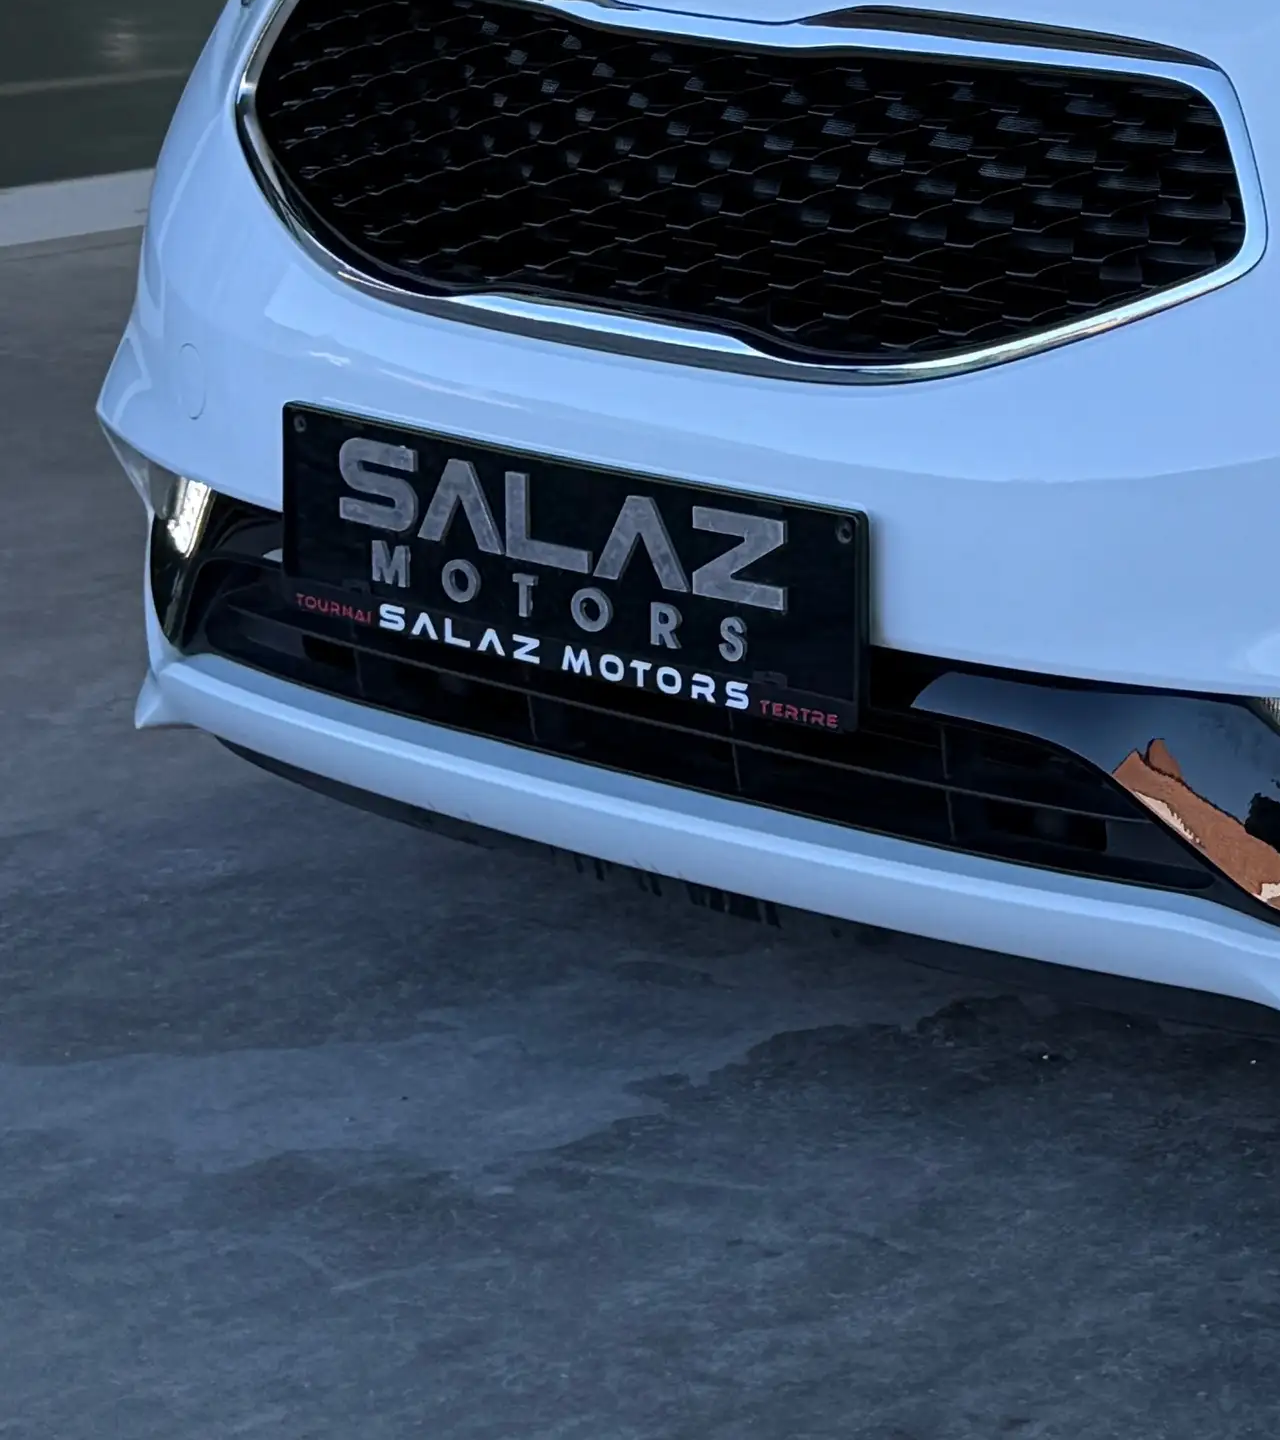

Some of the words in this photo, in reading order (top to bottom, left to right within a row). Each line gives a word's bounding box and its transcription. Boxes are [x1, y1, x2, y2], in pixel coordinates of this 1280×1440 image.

[338, 436, 788, 613] SALAZ
[296, 592, 372, 625] TOURNAI
[379, 603, 541, 664] SALAZ
[561, 644, 750, 710] MOTORS
[759, 699, 839, 729] TERTRE
[371, 539, 748, 662] MOTORS
